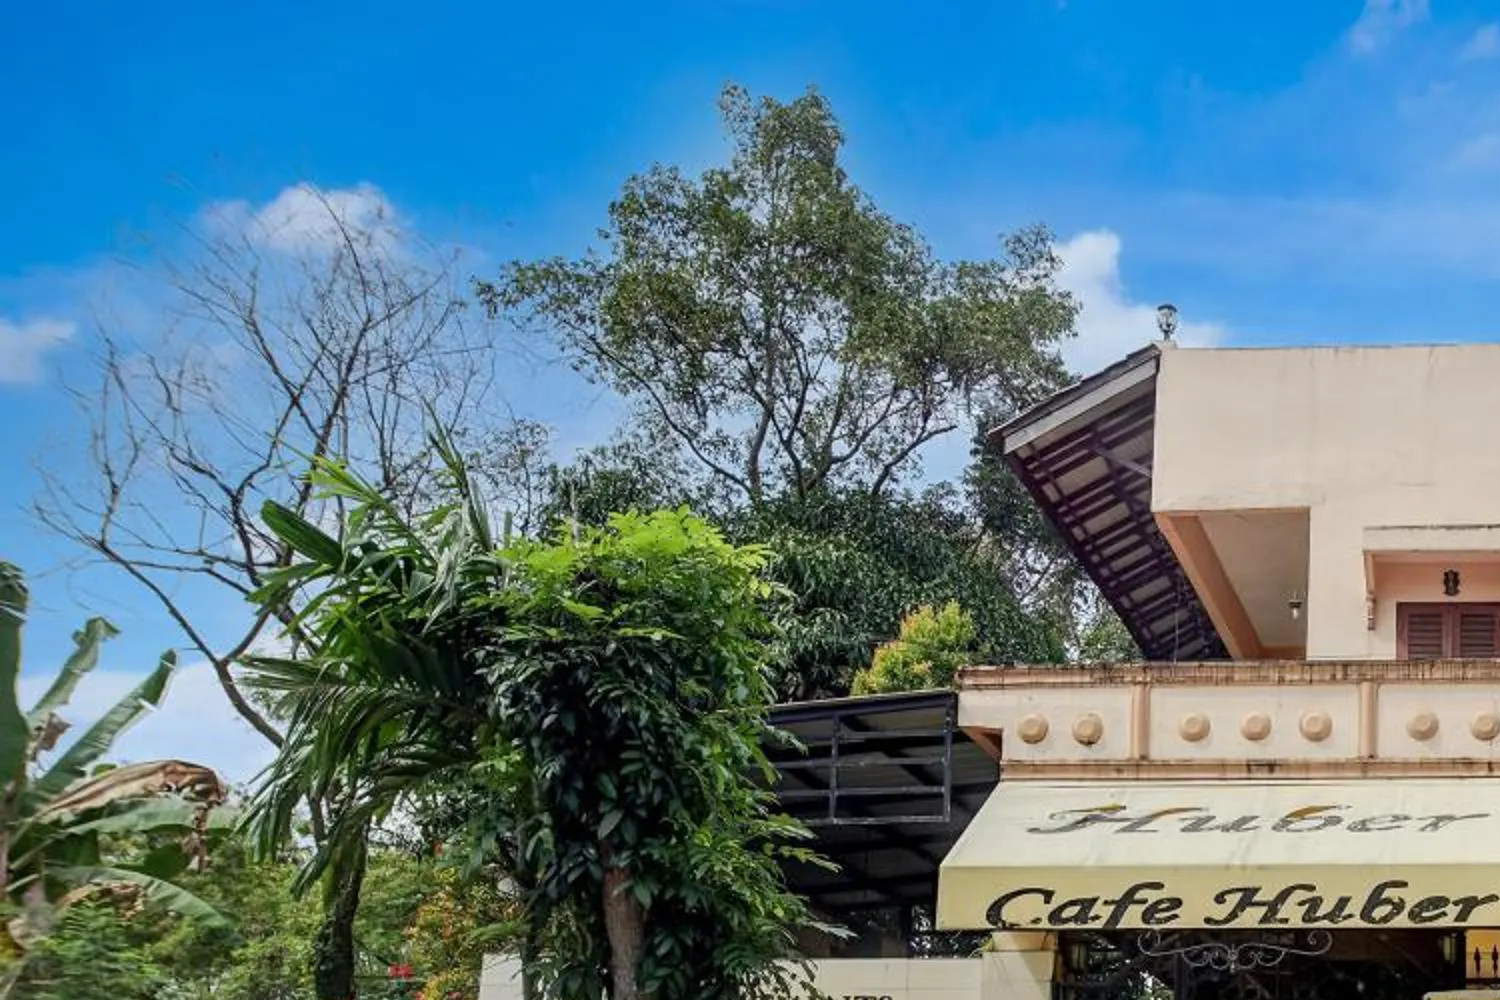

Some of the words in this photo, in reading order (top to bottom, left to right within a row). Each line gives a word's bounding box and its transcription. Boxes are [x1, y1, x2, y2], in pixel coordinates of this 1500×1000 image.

[1026, 801, 1491, 834] Huber
[986, 880, 1184, 931] Cafe
[1203, 880, 1500, 928] Huber
